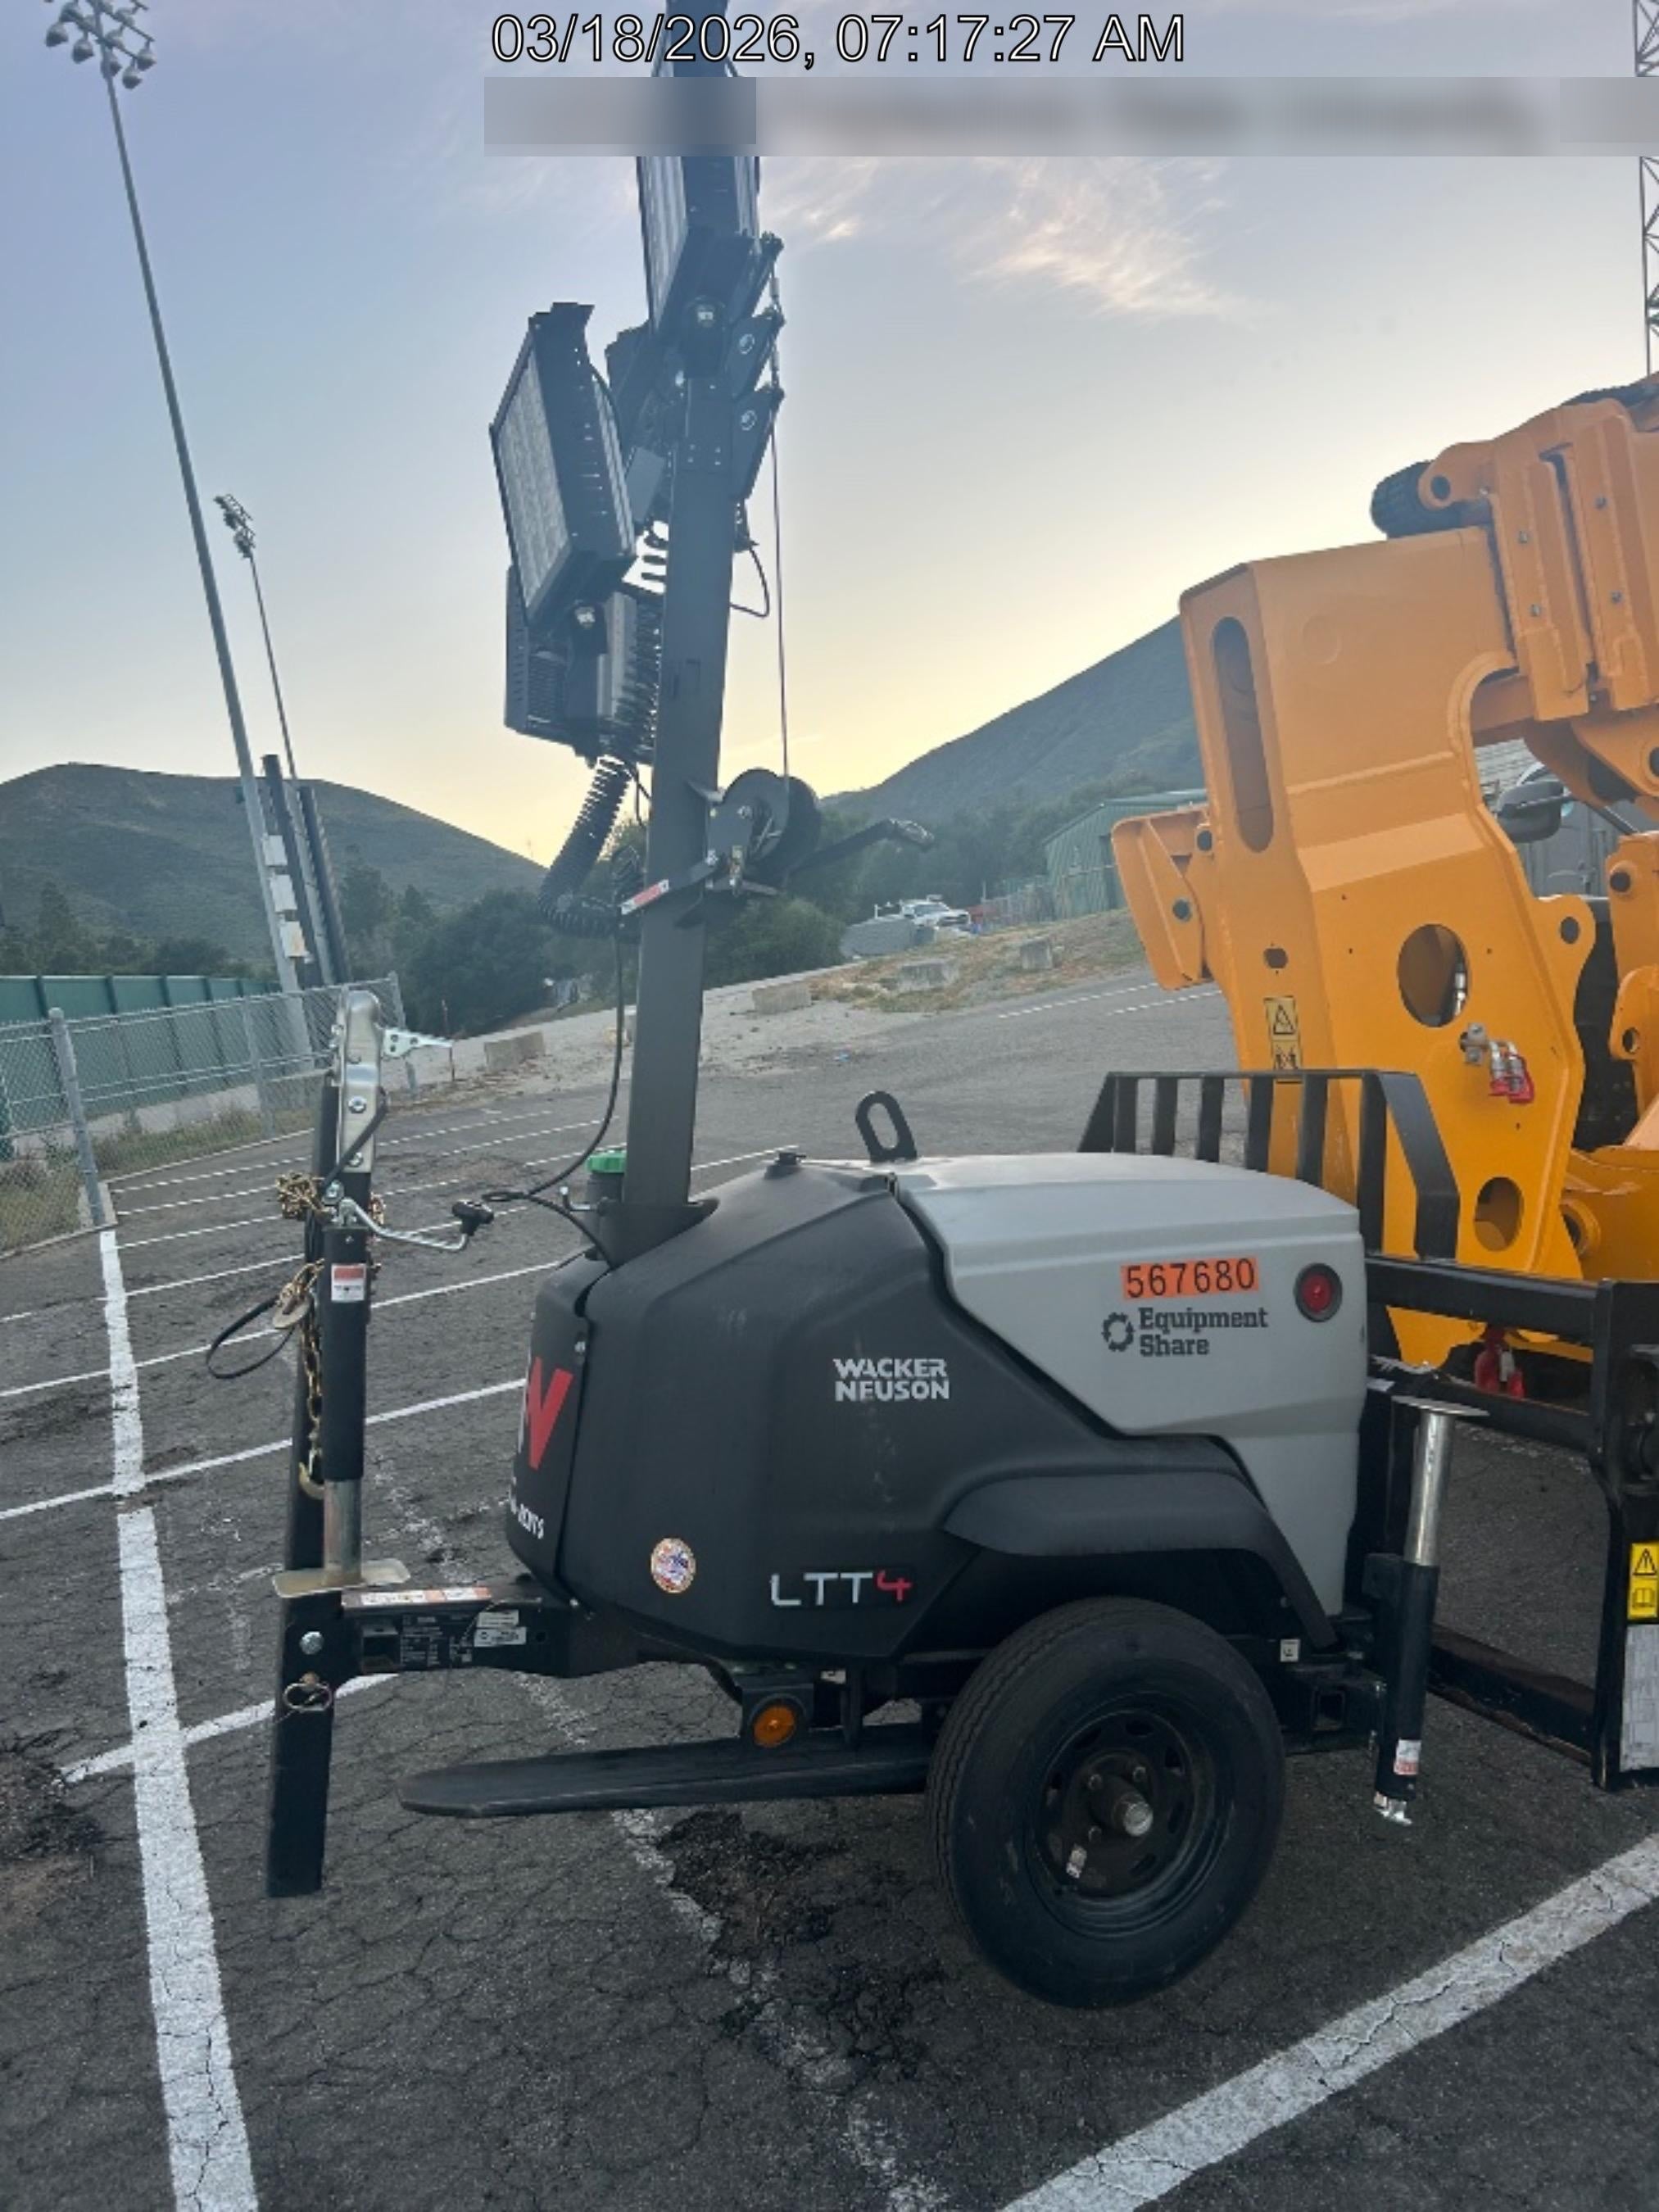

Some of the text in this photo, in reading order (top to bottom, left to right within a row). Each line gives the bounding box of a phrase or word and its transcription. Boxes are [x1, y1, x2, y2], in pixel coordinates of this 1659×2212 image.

[1126, 1258, 1255, 1298] 567680
[1138, 1307, 1268, 1333] Equipment
[1140, 1335, 1210, 1357] Share
[833, 1358, 947, 1379] WACKER
[835, 1380, 950, 1402] NEUSON
[770, 1571, 913, 1607] LTT4
